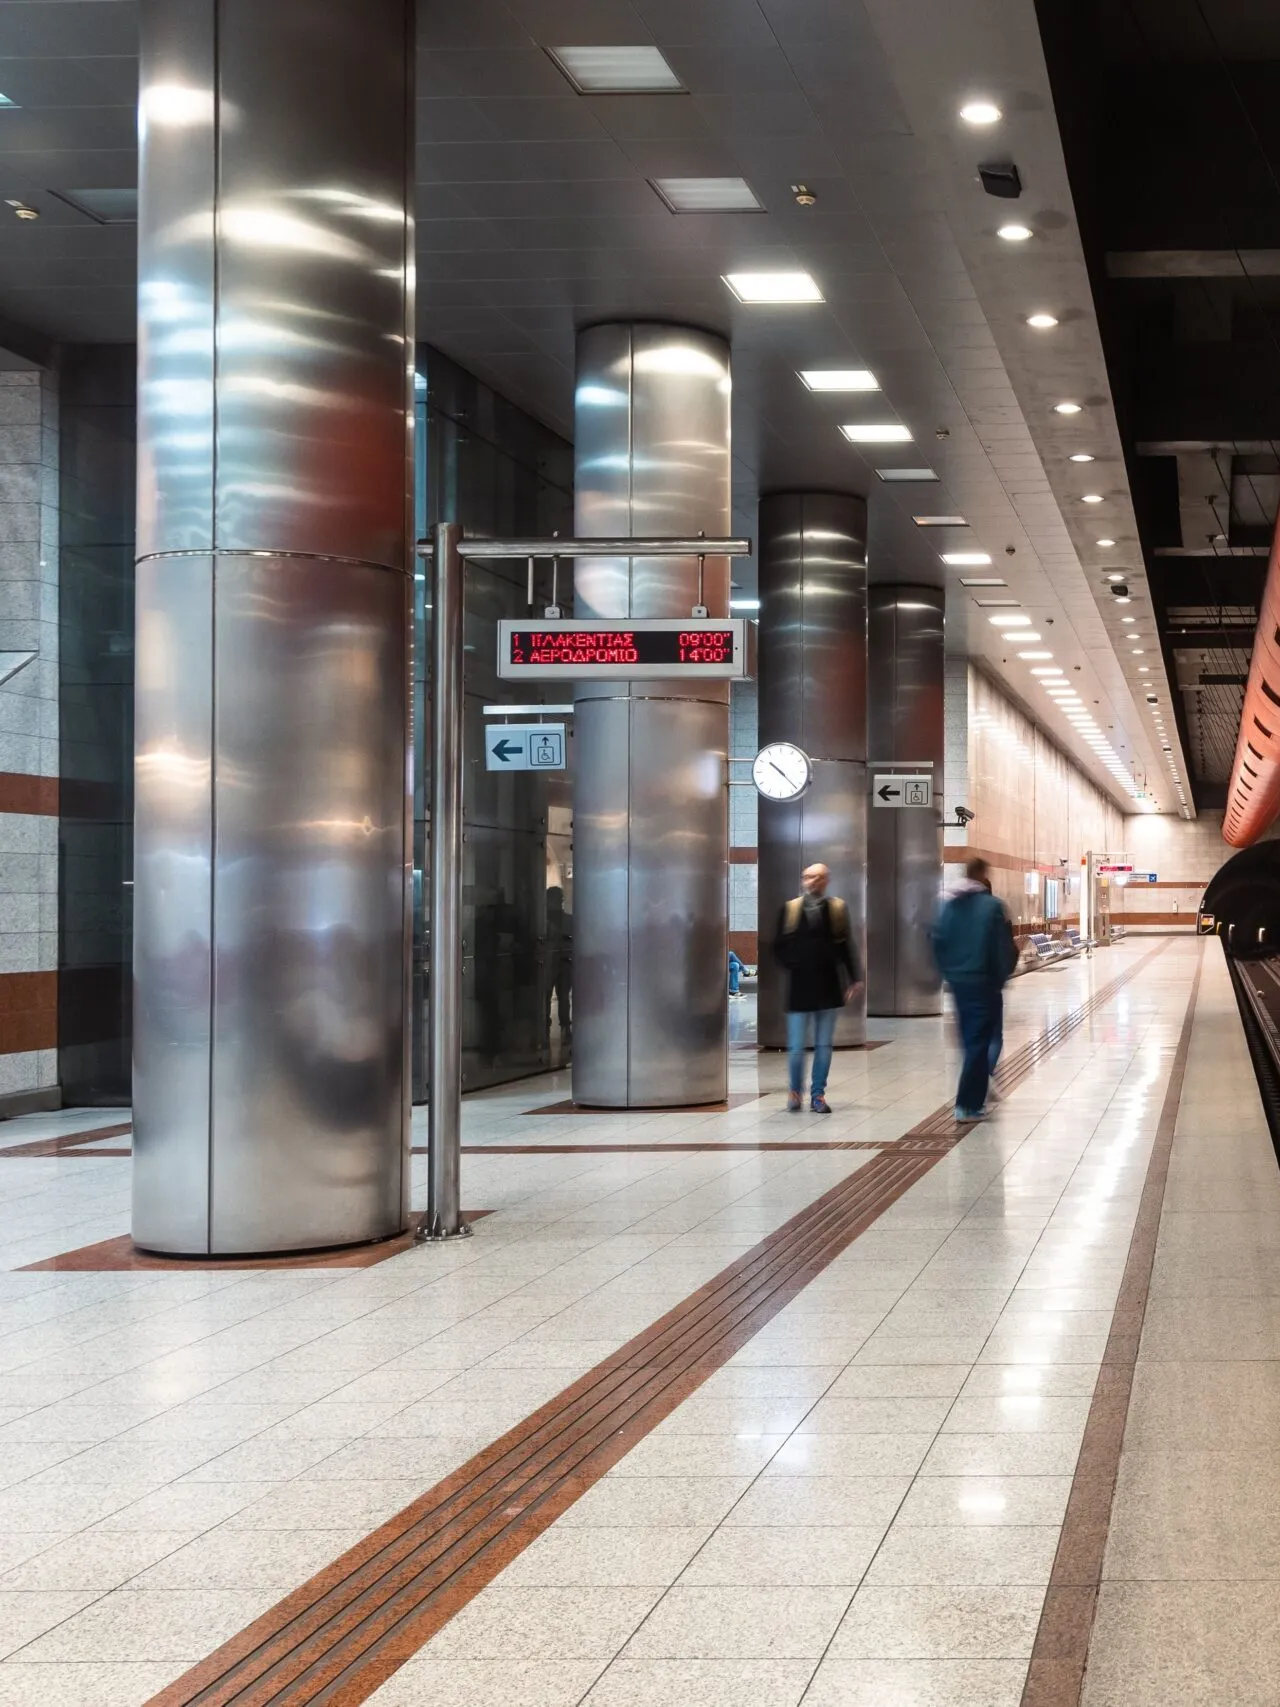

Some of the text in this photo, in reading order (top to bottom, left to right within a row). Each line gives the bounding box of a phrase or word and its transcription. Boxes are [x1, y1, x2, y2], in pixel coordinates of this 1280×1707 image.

[513, 633, 519, 647] 1
[530, 633, 634, 647] ΠΛΑΚΕΝΤΙΑΣ
[513, 649, 524, 662] 2
[530, 648, 639, 662] ΑΕΡΟΔΡΟΜΙΟ
